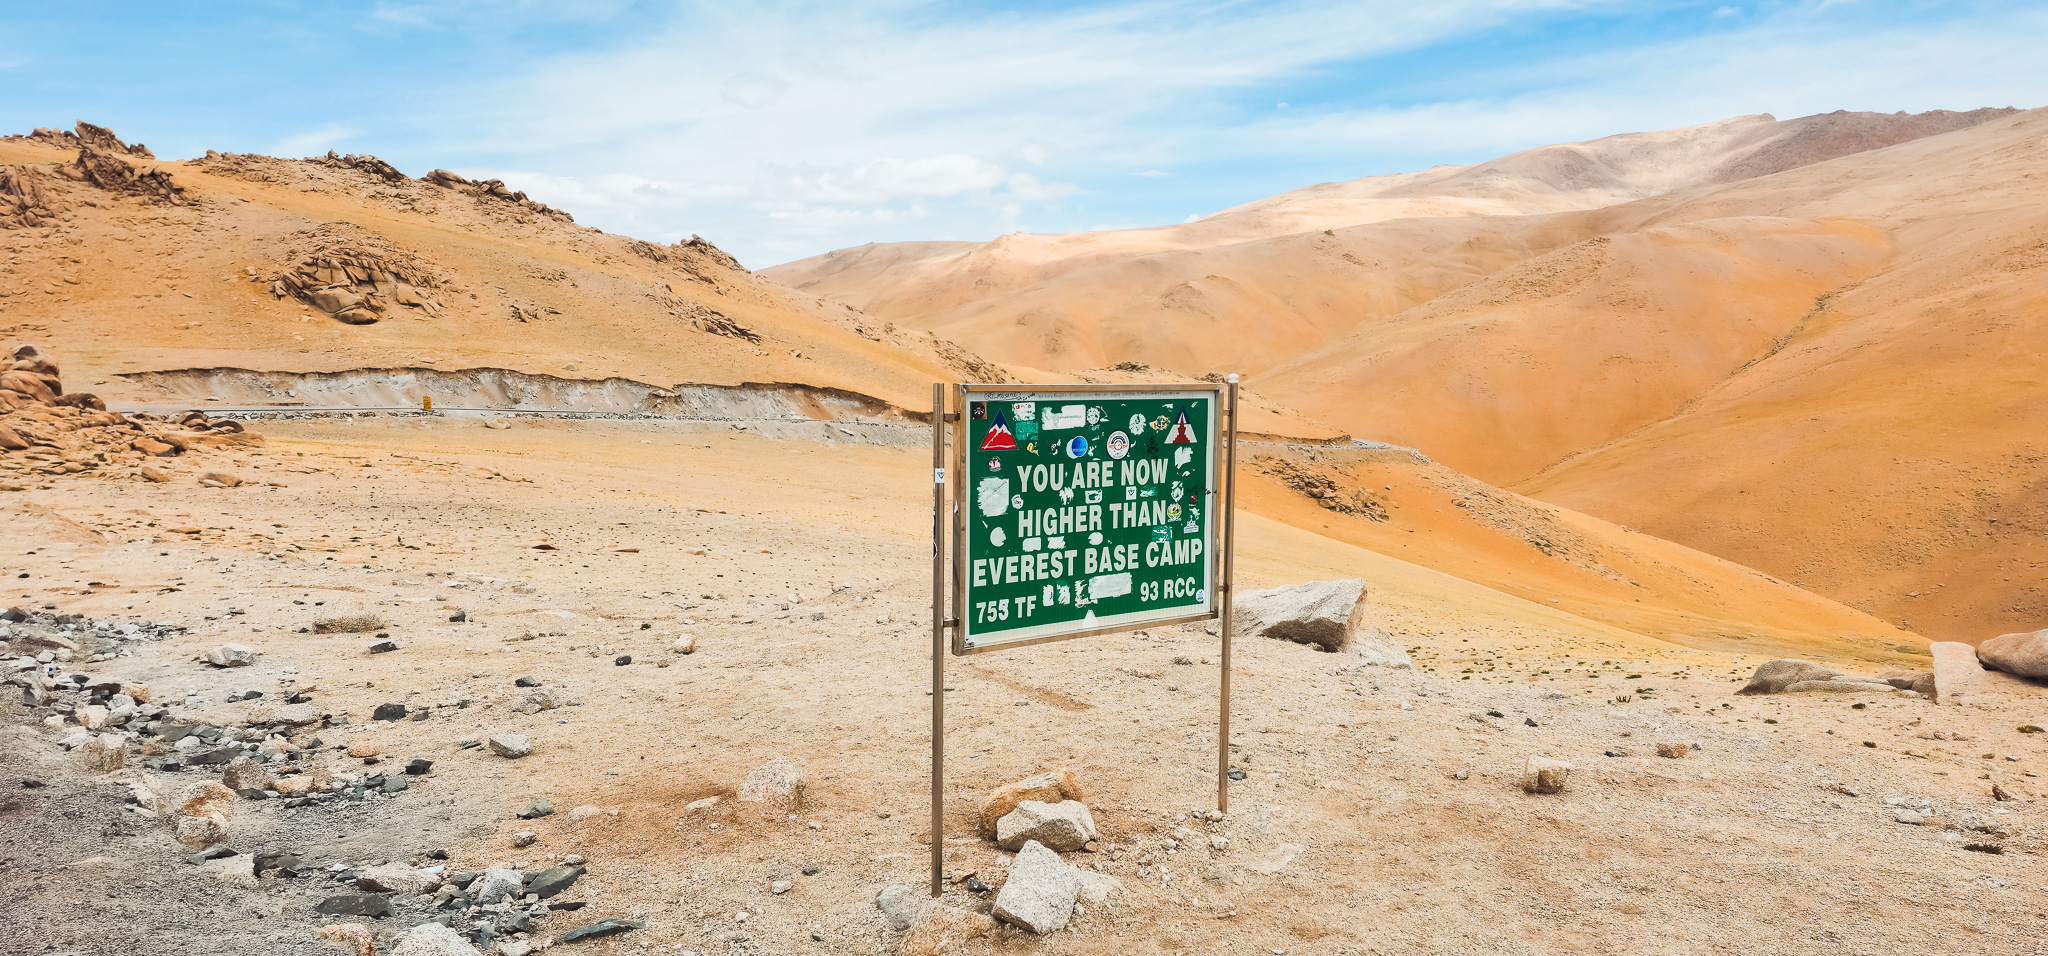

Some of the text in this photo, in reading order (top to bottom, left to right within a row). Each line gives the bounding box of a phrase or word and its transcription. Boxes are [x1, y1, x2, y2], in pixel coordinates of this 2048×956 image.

[1017, 463, 1064, 493] YOU
[1071, 460, 1114, 489] ARE
[1121, 458, 1169, 486] NOW
[1018, 500, 1166, 538] HIGHER THAN
[973, 538, 1203, 588] EVEREST BASE CAMP
[1014, 595, 1037, 619] TF
[1140, 581, 1159, 602] 93
[1163, 577, 1196, 600] RCC
